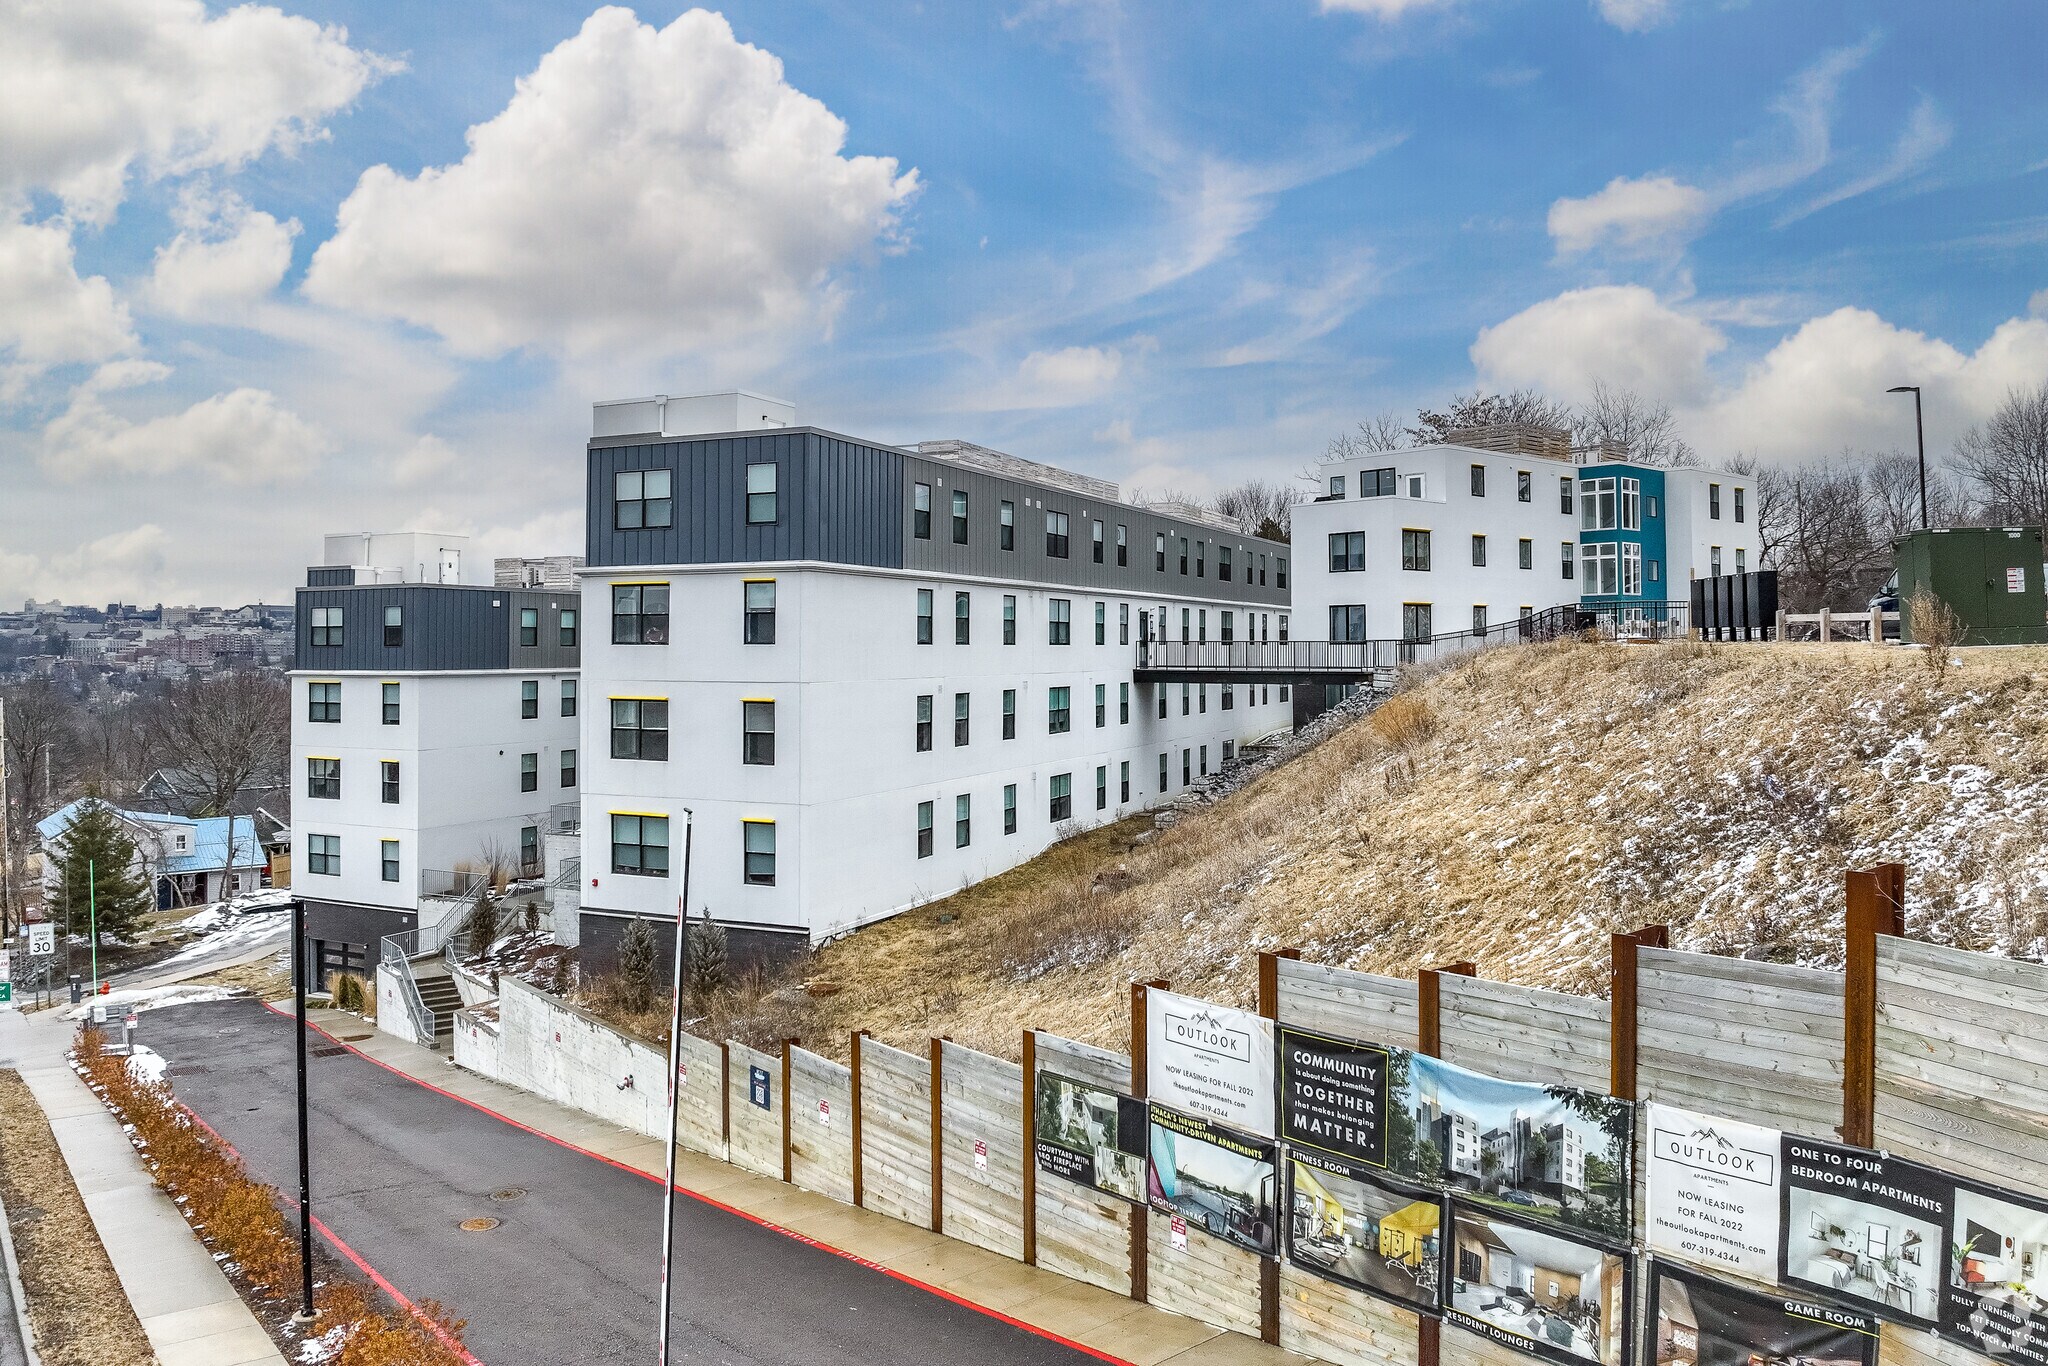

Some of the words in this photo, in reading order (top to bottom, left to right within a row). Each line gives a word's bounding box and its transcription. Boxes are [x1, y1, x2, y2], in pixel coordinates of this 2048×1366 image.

[33, 942, 50, 952] 30
[1177, 1025, 1237, 1050] OUTLOOK
[1194, 1053, 1220, 1064] APARTMENTS
[1293, 1050, 1376, 1080] COMMUNITY
[1165, 1065, 1181, 1074] NOW
[1183, 1070, 1208, 1083] LEASING
[1209, 1077, 1222, 1087] FOR
[1223, 1081, 1236, 1092] FALL
[1238, 1086, 1254, 1096] 2022
[1295, 1068, 1301, 1076] is
[1302, 1069, 1321, 1080] about
[1321, 1075, 1341, 1087] doing
[1342, 1080, 1375, 1096] something
[1173, 1081, 1246, 1109] theoutlookapartments.com
[1189, 1100, 1228, 1117] 607-319-4344
[1294, 1081, 1375, 1114] TOGETHER
[1150, 1105, 1177, 1122] ITHACA'S
[1179, 1116, 1207, 1131] NEWEST
[1294, 1100, 1310, 1110] that
[1311, 1104, 1335, 1117] makes
[1337, 1110, 1375, 1129] belonging
[1150, 1113, 1216, 1143] COMMUNITY-DRIVEN
[1218, 1137, 1262, 1159] APARTMENTS
[1293, 1113, 1375, 1149] MATTER.
[1037, 1143, 1073, 1159] COURTYARD
[1074, 1154, 1090, 1166] WITH
[1053, 1155, 1082, 1172] FIREPLACE
[1292, 1151, 1322, 1167] FITNESS
[1324, 1161, 1350, 1176] ROOM
[1670, 1142, 1755, 1172] OUTLOOK
[1790, 1146, 1819, 1161] ONE
[1823, 1152, 1841, 1165] TO
[1846, 1157, 1883, 1175] FOUR
[1053, 1163, 1071, 1176] MORE
[1693, 1173, 1729, 1186] APARTMENTS
[1677, 1189, 1702, 1202] NOW
[1704, 1197, 1745, 1214] LEASING
[1791, 1165, 1858, 1188] BEDROOM
[1861, 1181, 1942, 1213] APARTMENTS
[1677, 1206, 1696, 1218] FOR
[1699, 1212, 1718, 1225] FALL
[1720, 1218, 1743, 1232] 2022
[1656, 1217, 1766, 1255] theoutlookapartments.com
[1680, 1240, 1740, 1264] 607-319-4344
[1784, 1301, 1821, 1319] GAME
[1825, 1312, 1866, 1328] ROOM
[1951, 1294, 1974, 1307] FULLY
[1977, 1302, 2021, 1324] FURNISHED
[2023, 1318, 2046, 1332] WITH
[1970, 1313, 1983, 1324] PET
[1985, 1318, 2021, 1338] FRIENDLY
[1447, 1310, 1487, 1333] RESIDENT
[1489, 1326, 1535, 1351] LOUNGES
[1955, 1322, 1999, 1346] TOP-NOTCH
[2001, 1341, 2045, 1362] AMENITIES
